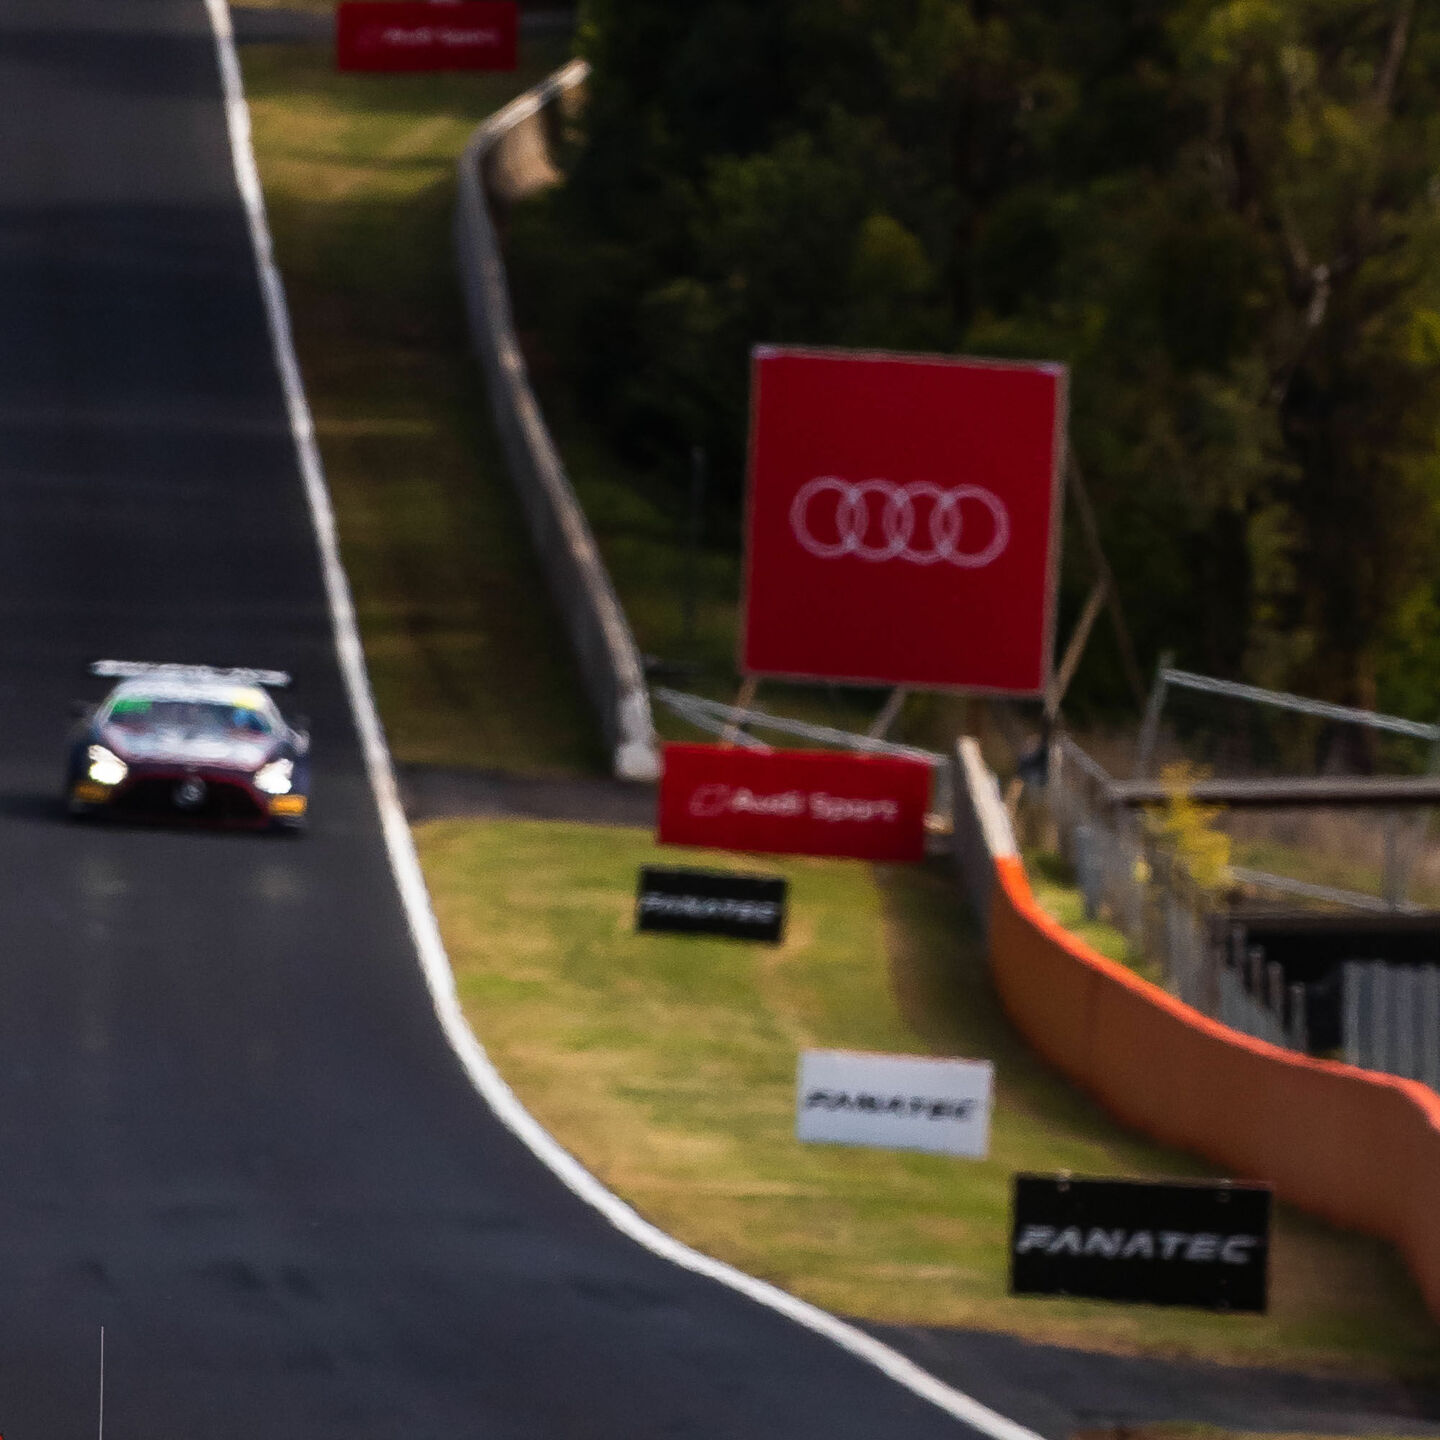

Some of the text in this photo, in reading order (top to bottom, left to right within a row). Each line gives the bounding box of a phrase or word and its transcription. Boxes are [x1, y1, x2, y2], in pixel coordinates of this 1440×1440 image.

[730, 788, 898, 822] Audi Sport
[640, 892, 773, 922] FANATEC
[806, 1088, 975, 1123] FANATEC
[1017, 1224, 1257, 1265] FANATEC
